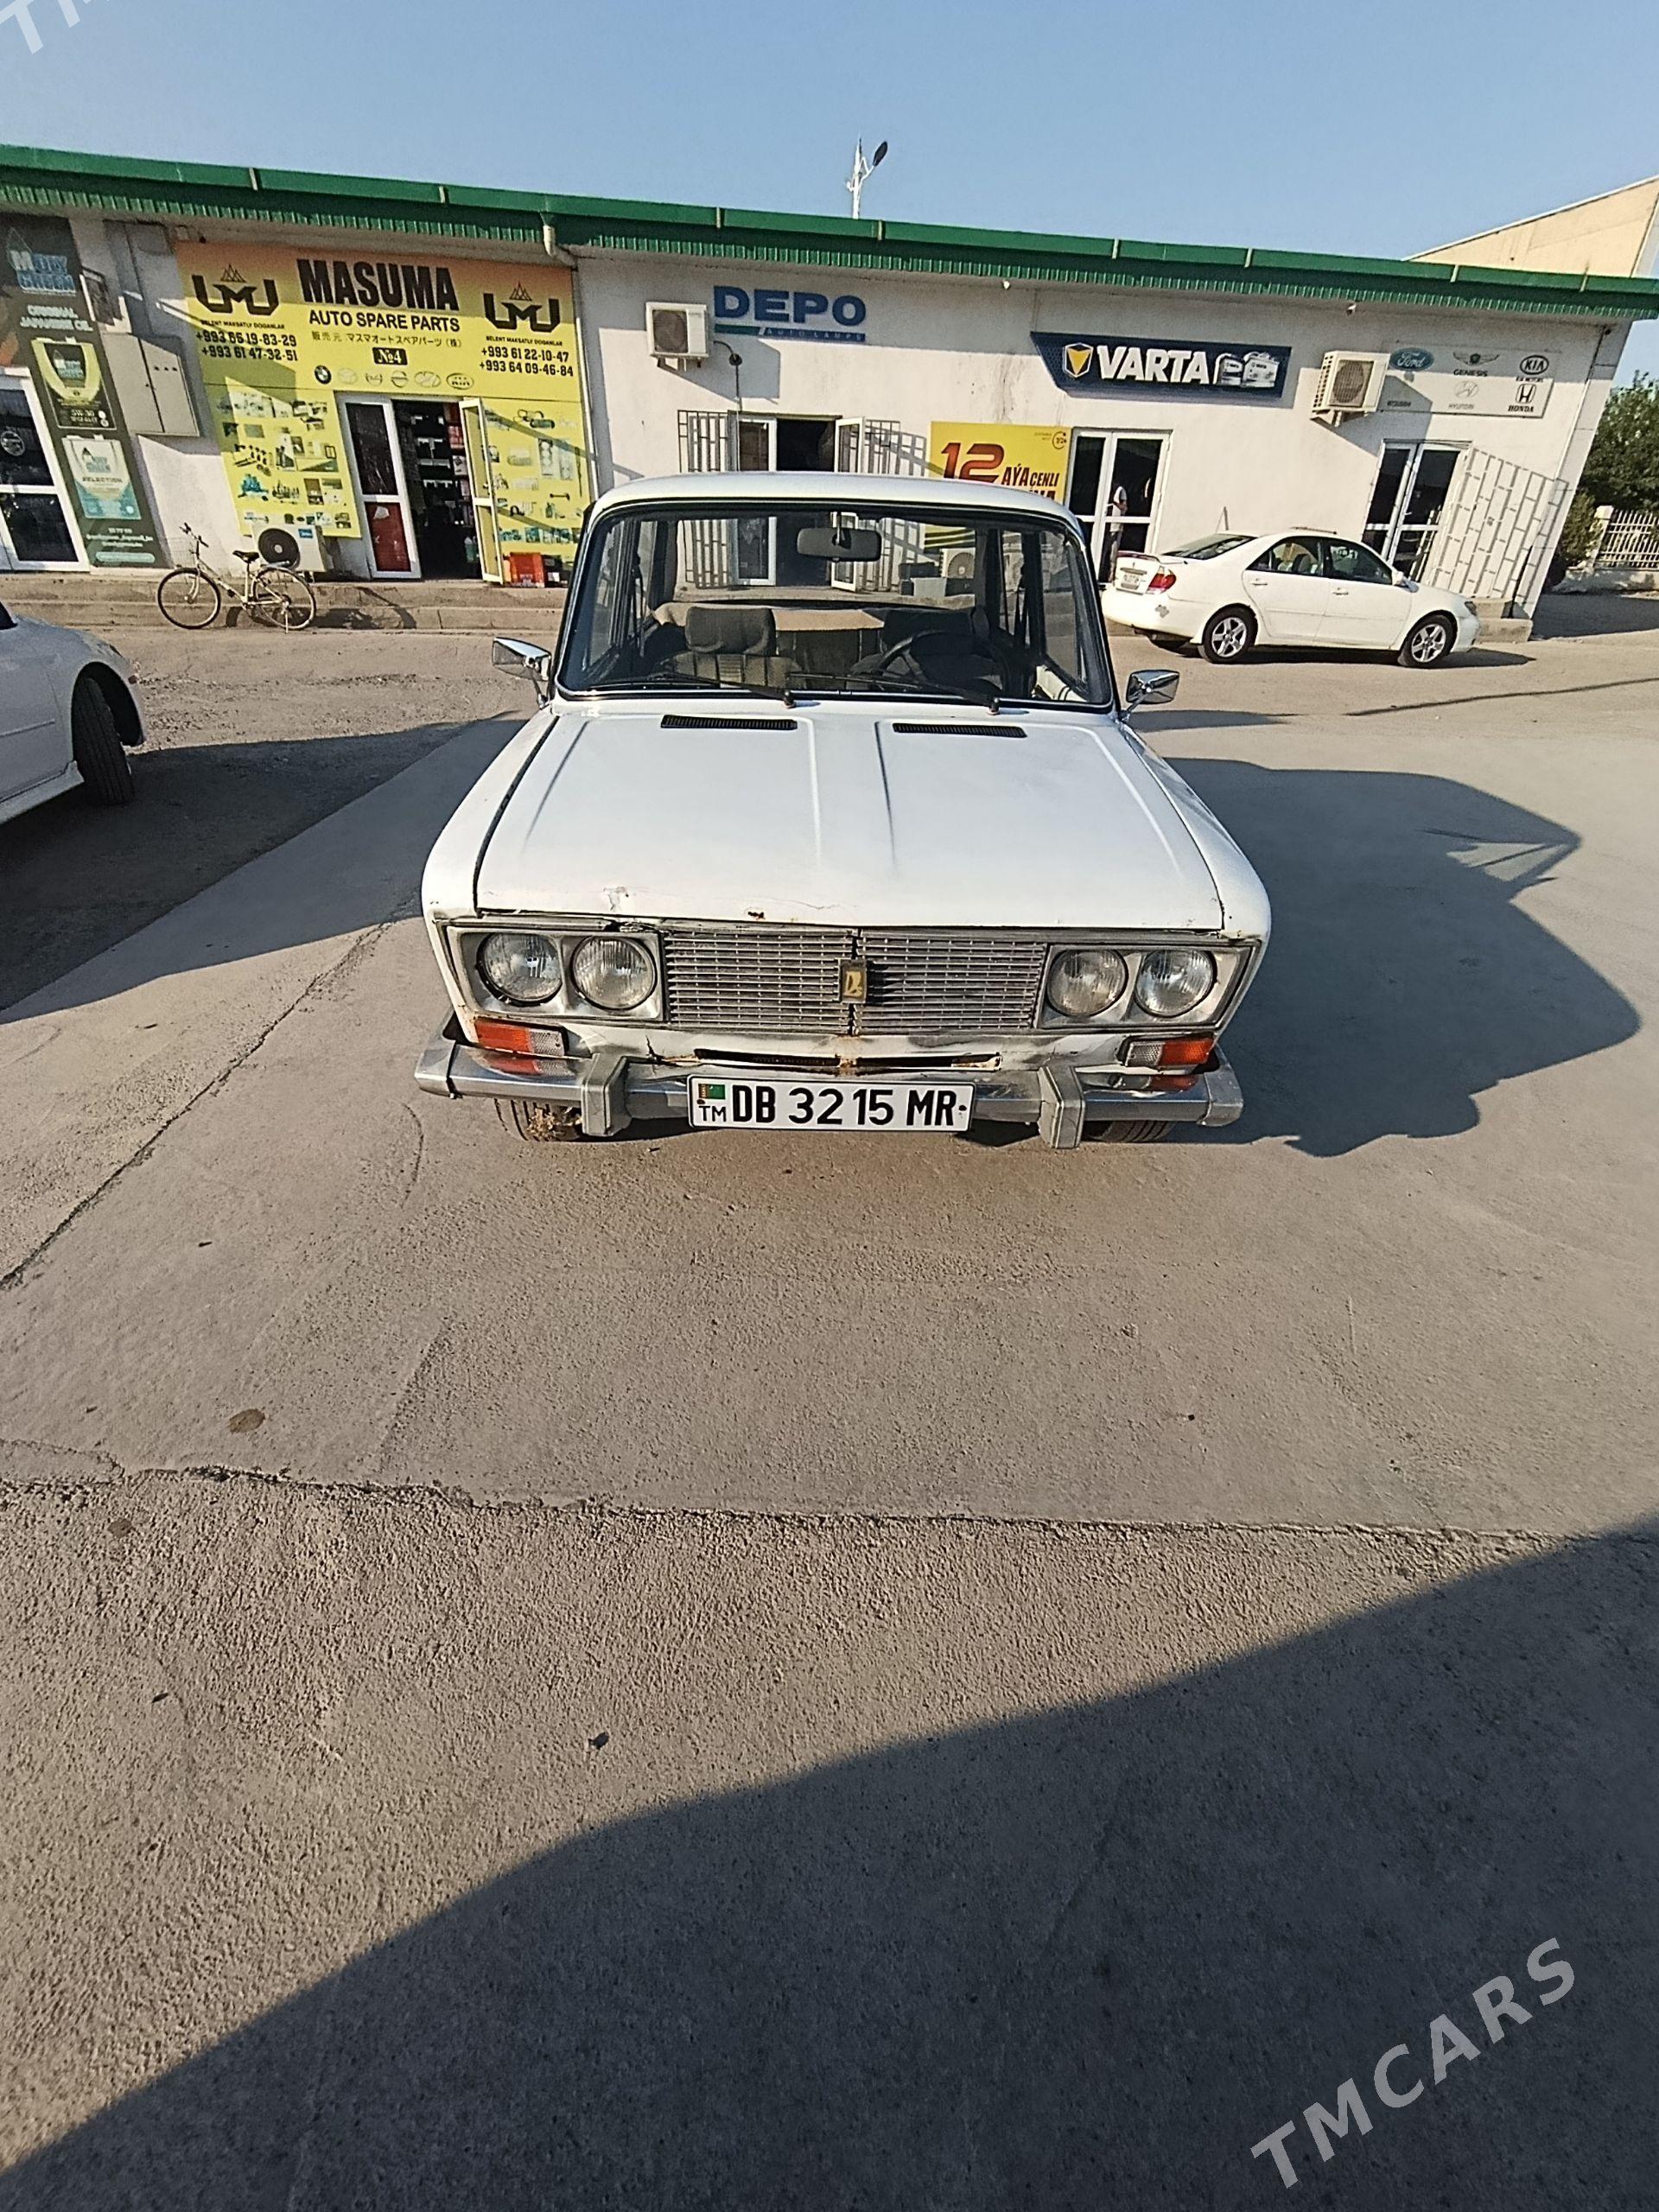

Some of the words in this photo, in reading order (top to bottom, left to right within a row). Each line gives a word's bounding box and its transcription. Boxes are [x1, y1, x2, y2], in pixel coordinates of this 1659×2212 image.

[297, 259, 460, 311] MASUMA
[714, 285, 867, 327] DEPO
[309, 310, 353, 326] AUTO
[357, 312, 408, 329] SPARE
[411, 316, 460, 332] PARTS
[196, 329, 226, 343] +993
[246, 333, 296, 346] 19-83-29
[813, 332, 861, 340] LAMPS
[202, 346, 231, 358] +993
[234, 346, 246, 359] 61
[249, 347, 298, 361] 47-32-51
[481, 346, 508, 359] +993
[511, 347, 522, 359] 61
[524, 349, 569, 362] 22-10-47
[1397, 353, 1426, 367] Ford
[480, 359, 506, 372] +993
[509, 361, 522, 373] 64
[524, 363, 574, 377] 09-46-84
[1096, 346, 1209, 385] VARTA
[1453, 369, 1488, 378] GENESIS
[1524, 359, 1544, 371] KIA
[941, 442, 1005, 483] 12
[1001, 463, 1030, 486] AÝA
[698, 1105, 727, 1122] TM
[732, 1085, 776, 1123] DB
[906, 1089, 957, 1126] MR
